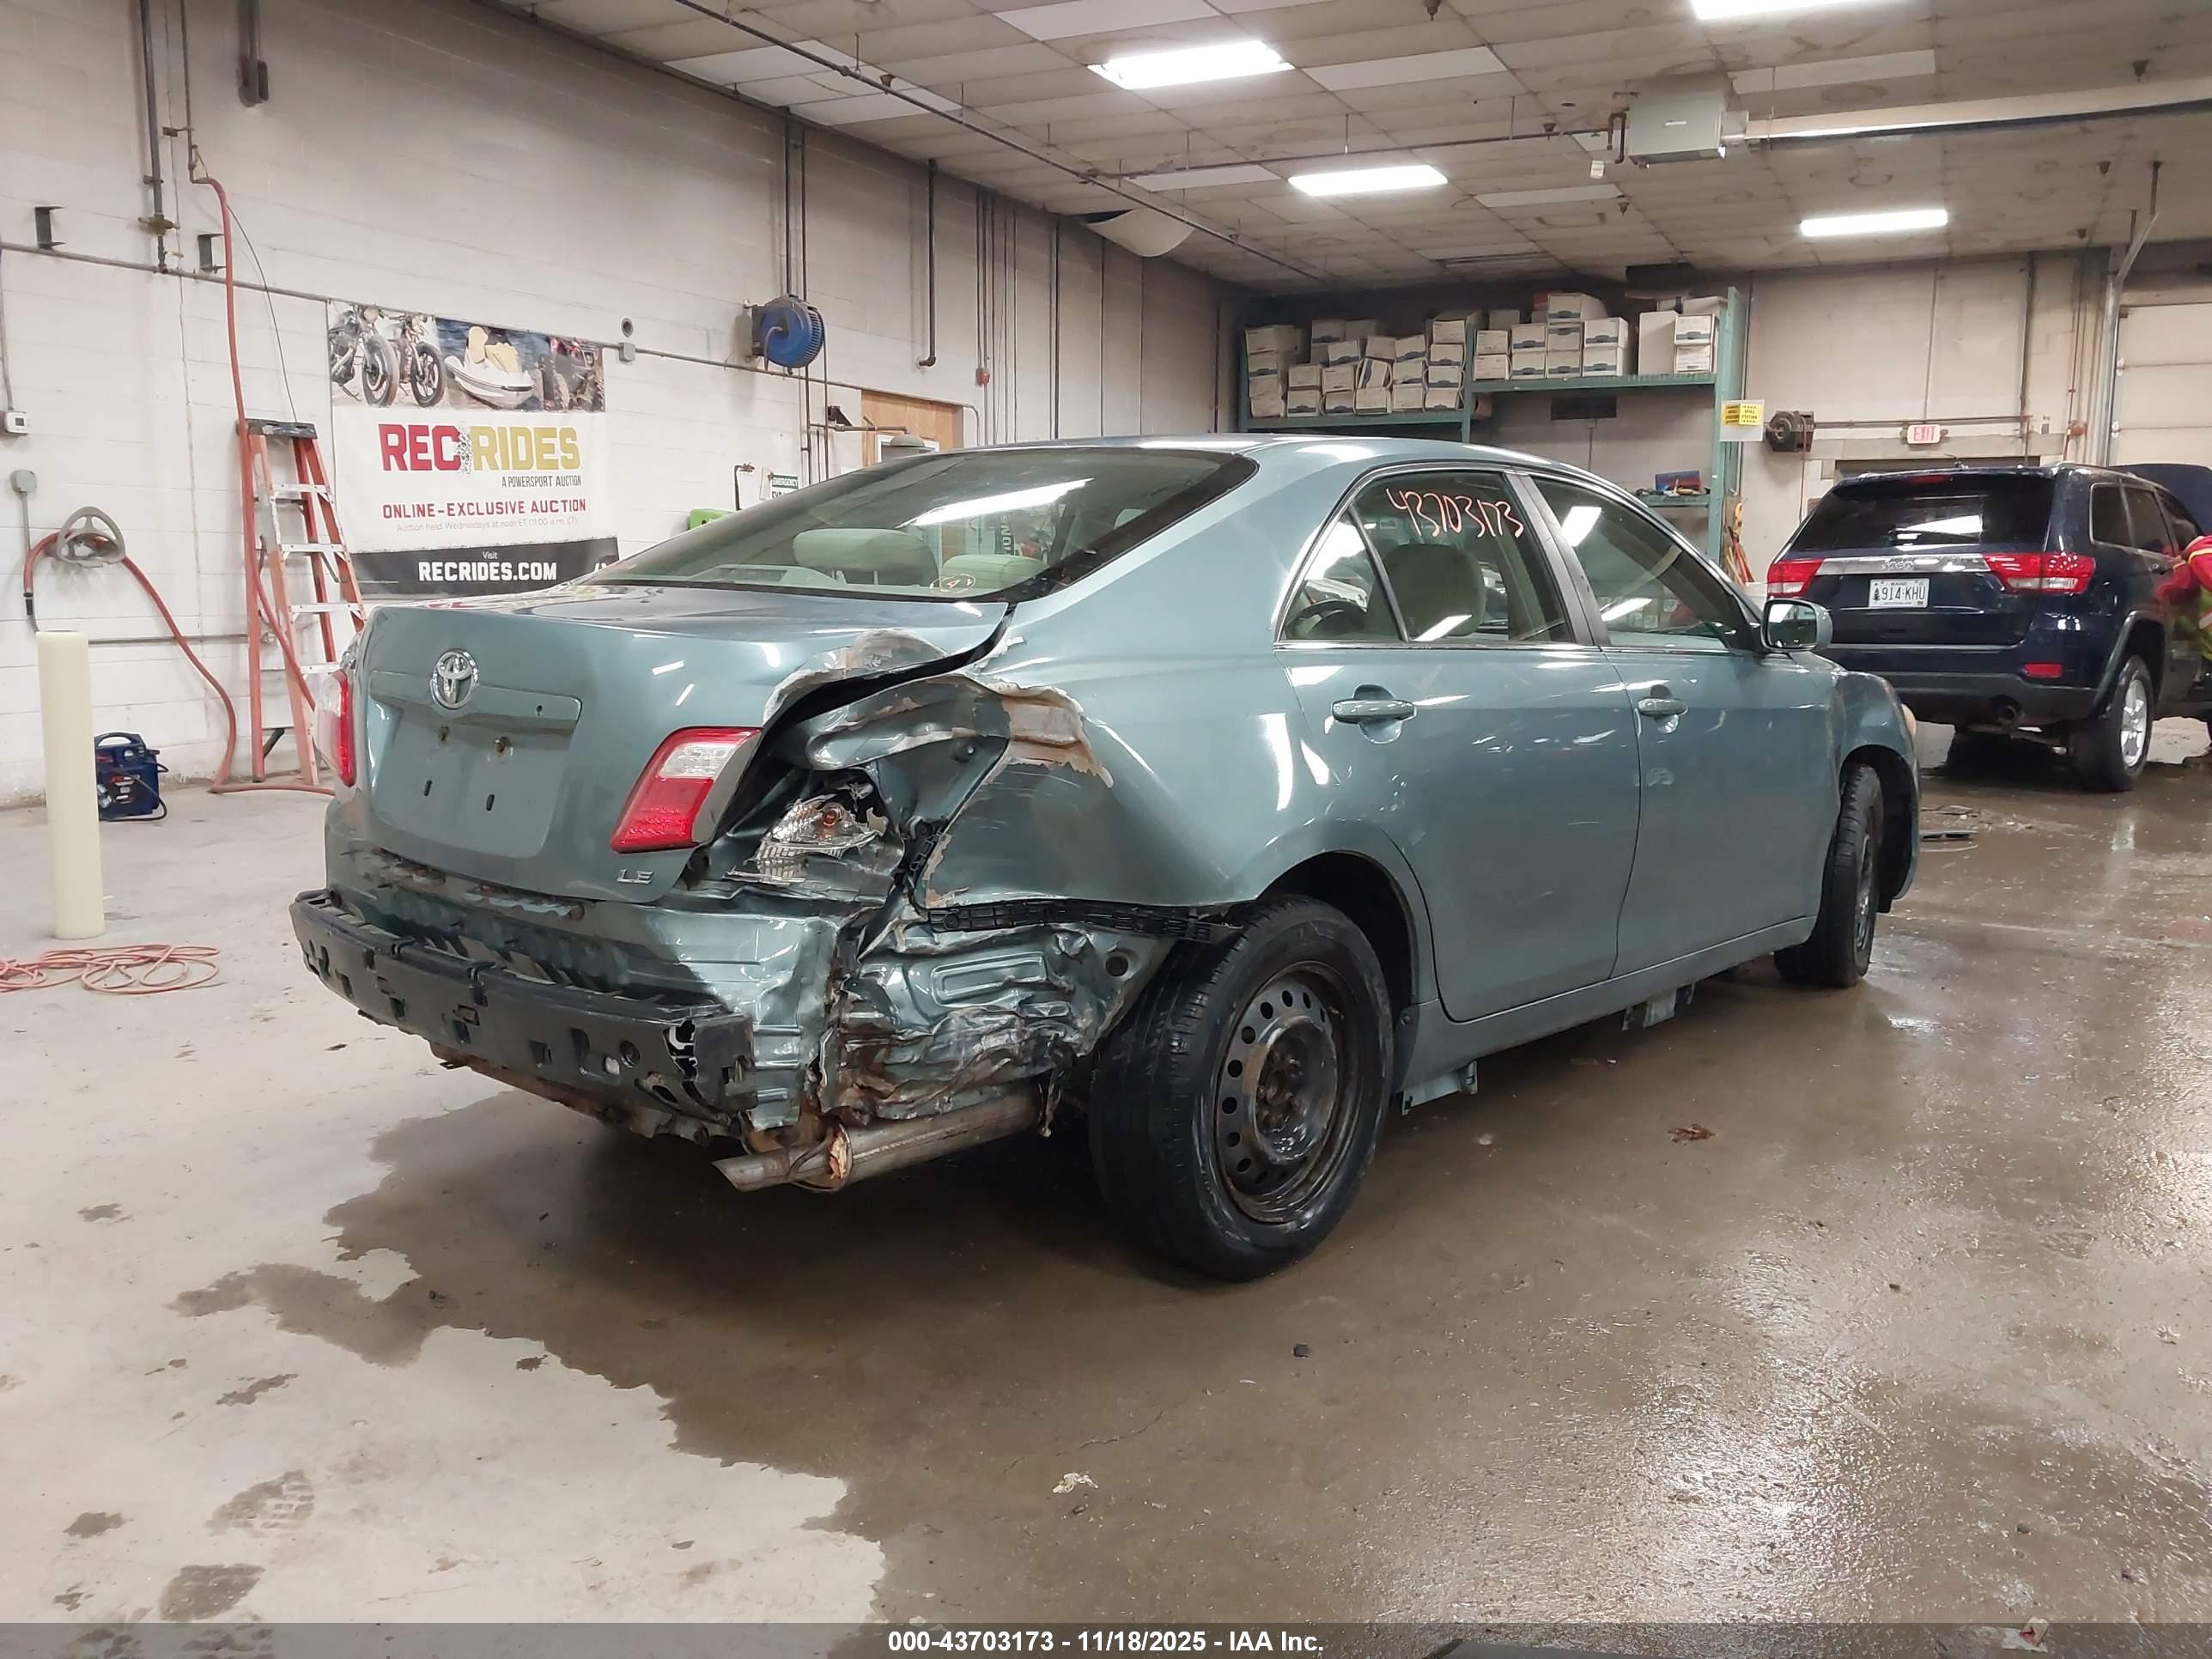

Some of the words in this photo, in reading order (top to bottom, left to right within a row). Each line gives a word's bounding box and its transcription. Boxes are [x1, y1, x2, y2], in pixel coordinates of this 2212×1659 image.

[1913, 426, 1936, 441] EXIT
[378, 423, 462, 471] REC
[471, 425, 581, 471] RIDES
[501, 477, 507, 488] A
[507, 476, 552, 488] POWERSPORT
[556, 474, 582, 487] AUCTION
[773, 477, 798, 488] EMERGENCY
[382, 500, 526, 520] ONLINE-EXCLUSIVE
[531, 498, 586, 514] AUCTION
[1385, 488, 1524, 538] 43703173
[482, 550, 498, 560] Visit
[418, 562, 557, 582] RECRIDES.COM
[617, 868, 653, 884] LE
